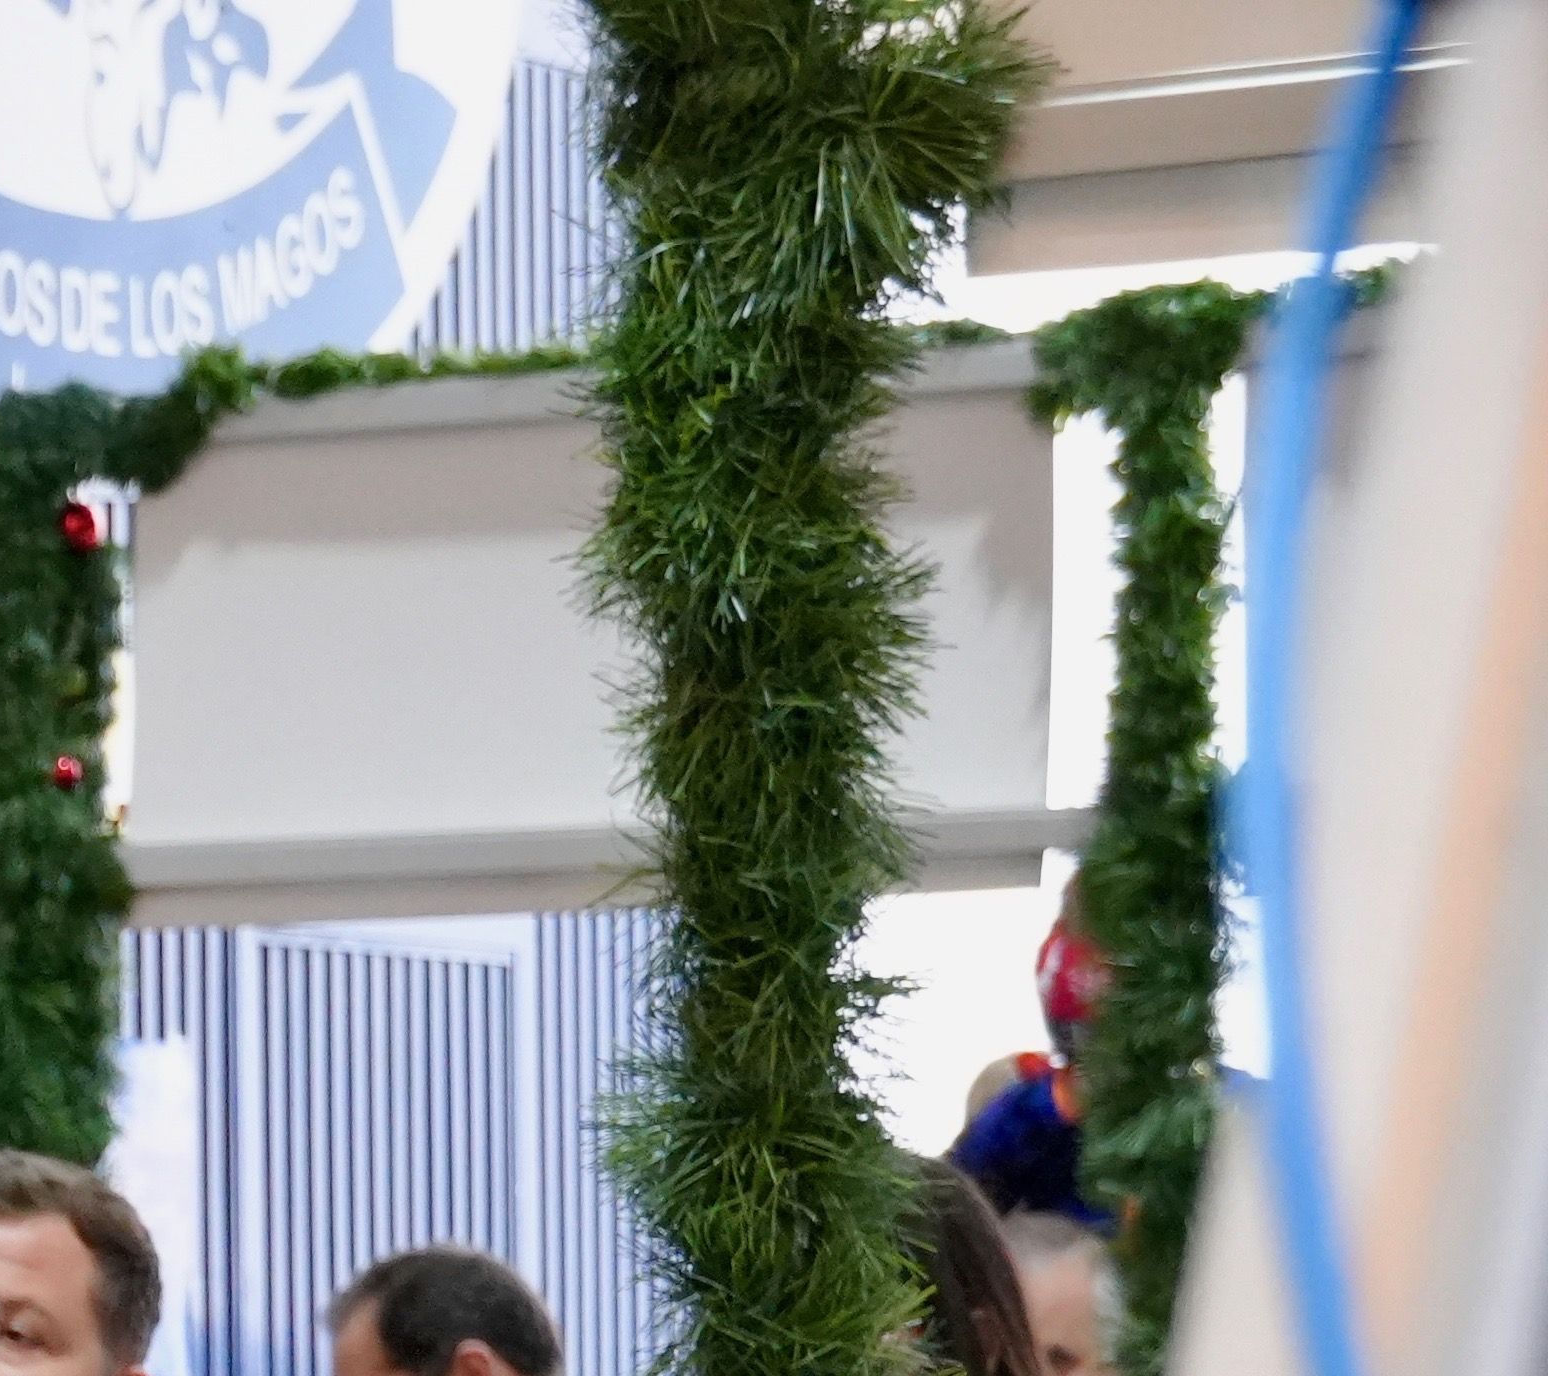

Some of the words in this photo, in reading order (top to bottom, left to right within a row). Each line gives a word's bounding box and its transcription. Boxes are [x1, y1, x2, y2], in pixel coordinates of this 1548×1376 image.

[60, 265, 123, 358] DE
[128, 263, 216, 358] LOS
[217, 165, 365, 335] MAGOS
